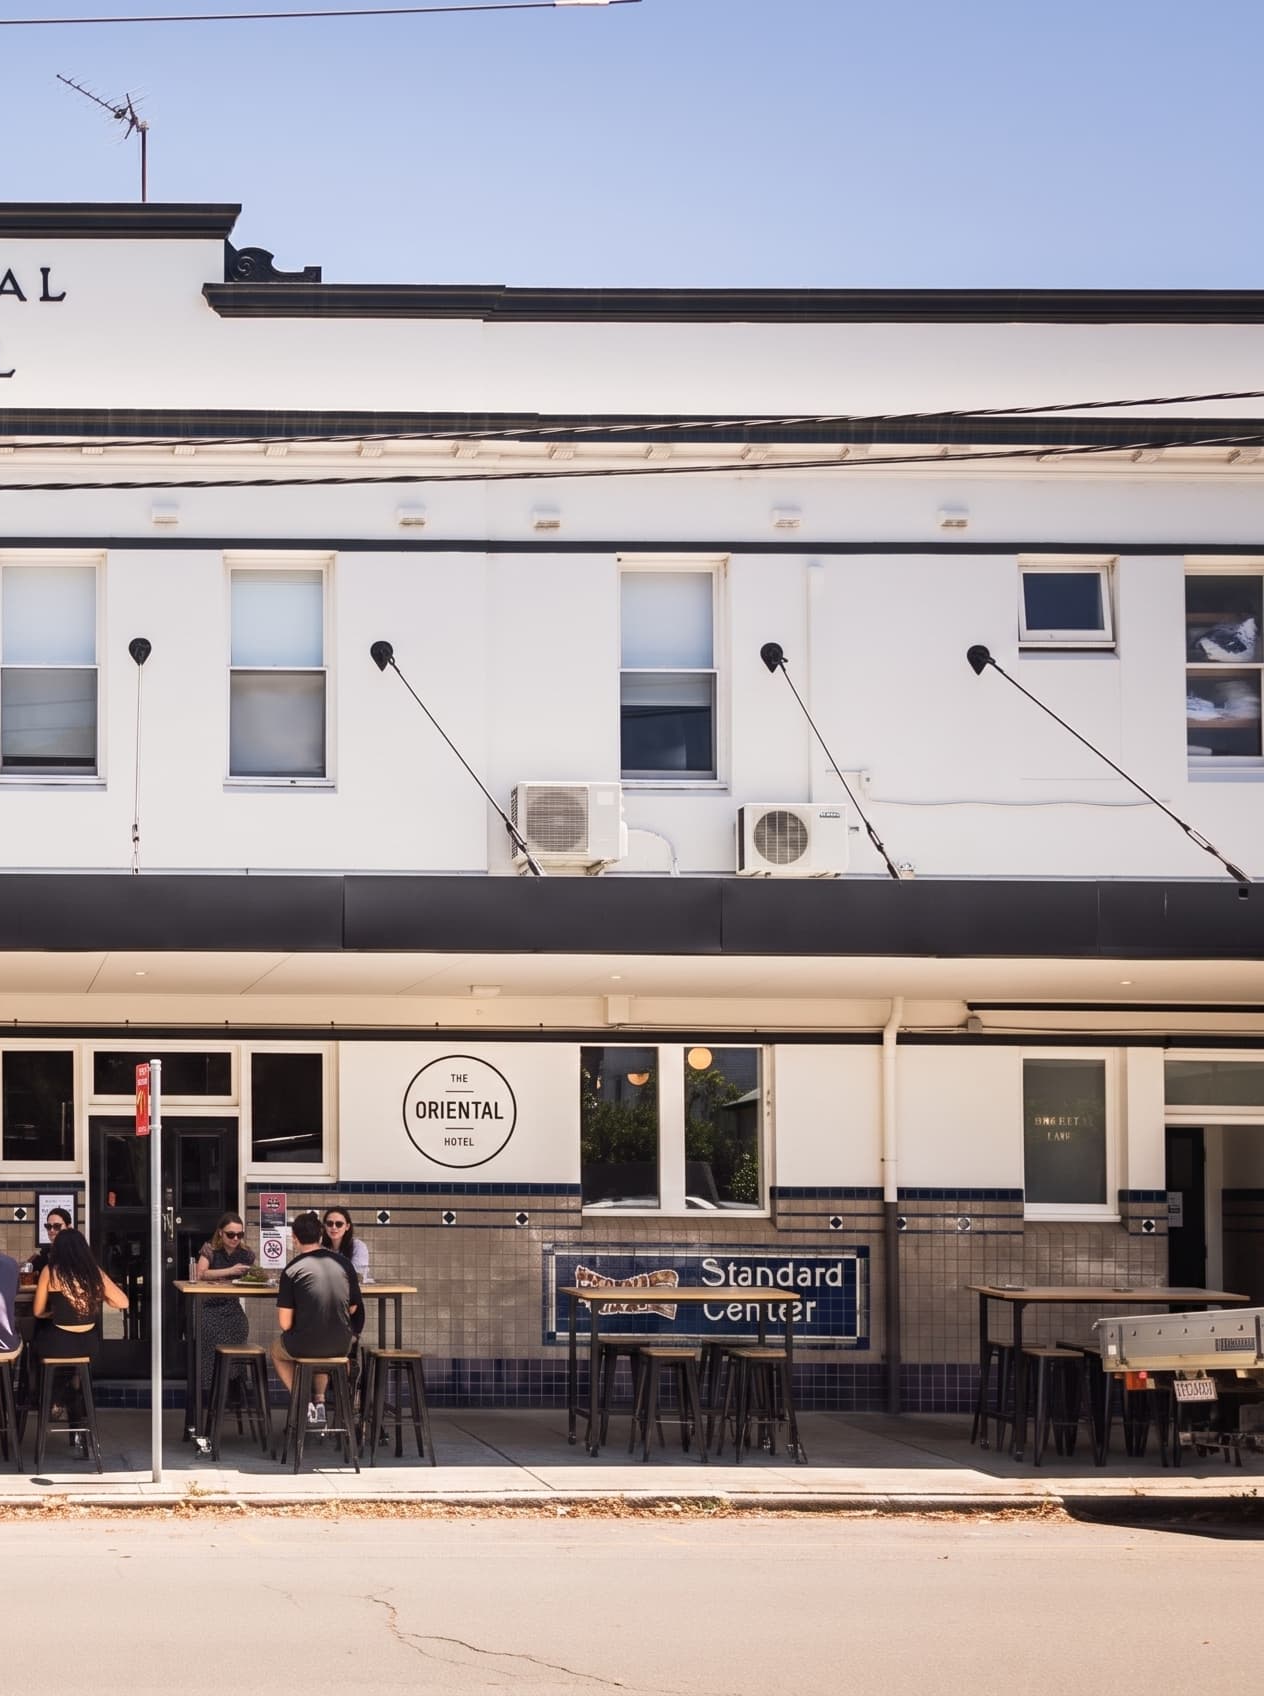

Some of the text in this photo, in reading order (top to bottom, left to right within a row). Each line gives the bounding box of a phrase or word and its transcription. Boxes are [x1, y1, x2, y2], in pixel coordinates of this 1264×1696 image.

[450, 1073, 469, 1083] THE
[415, 1100, 504, 1120] ORIENTAL
[444, 1137, 475, 1147] HOTEL
[701, 1257, 843, 1288] Standard
